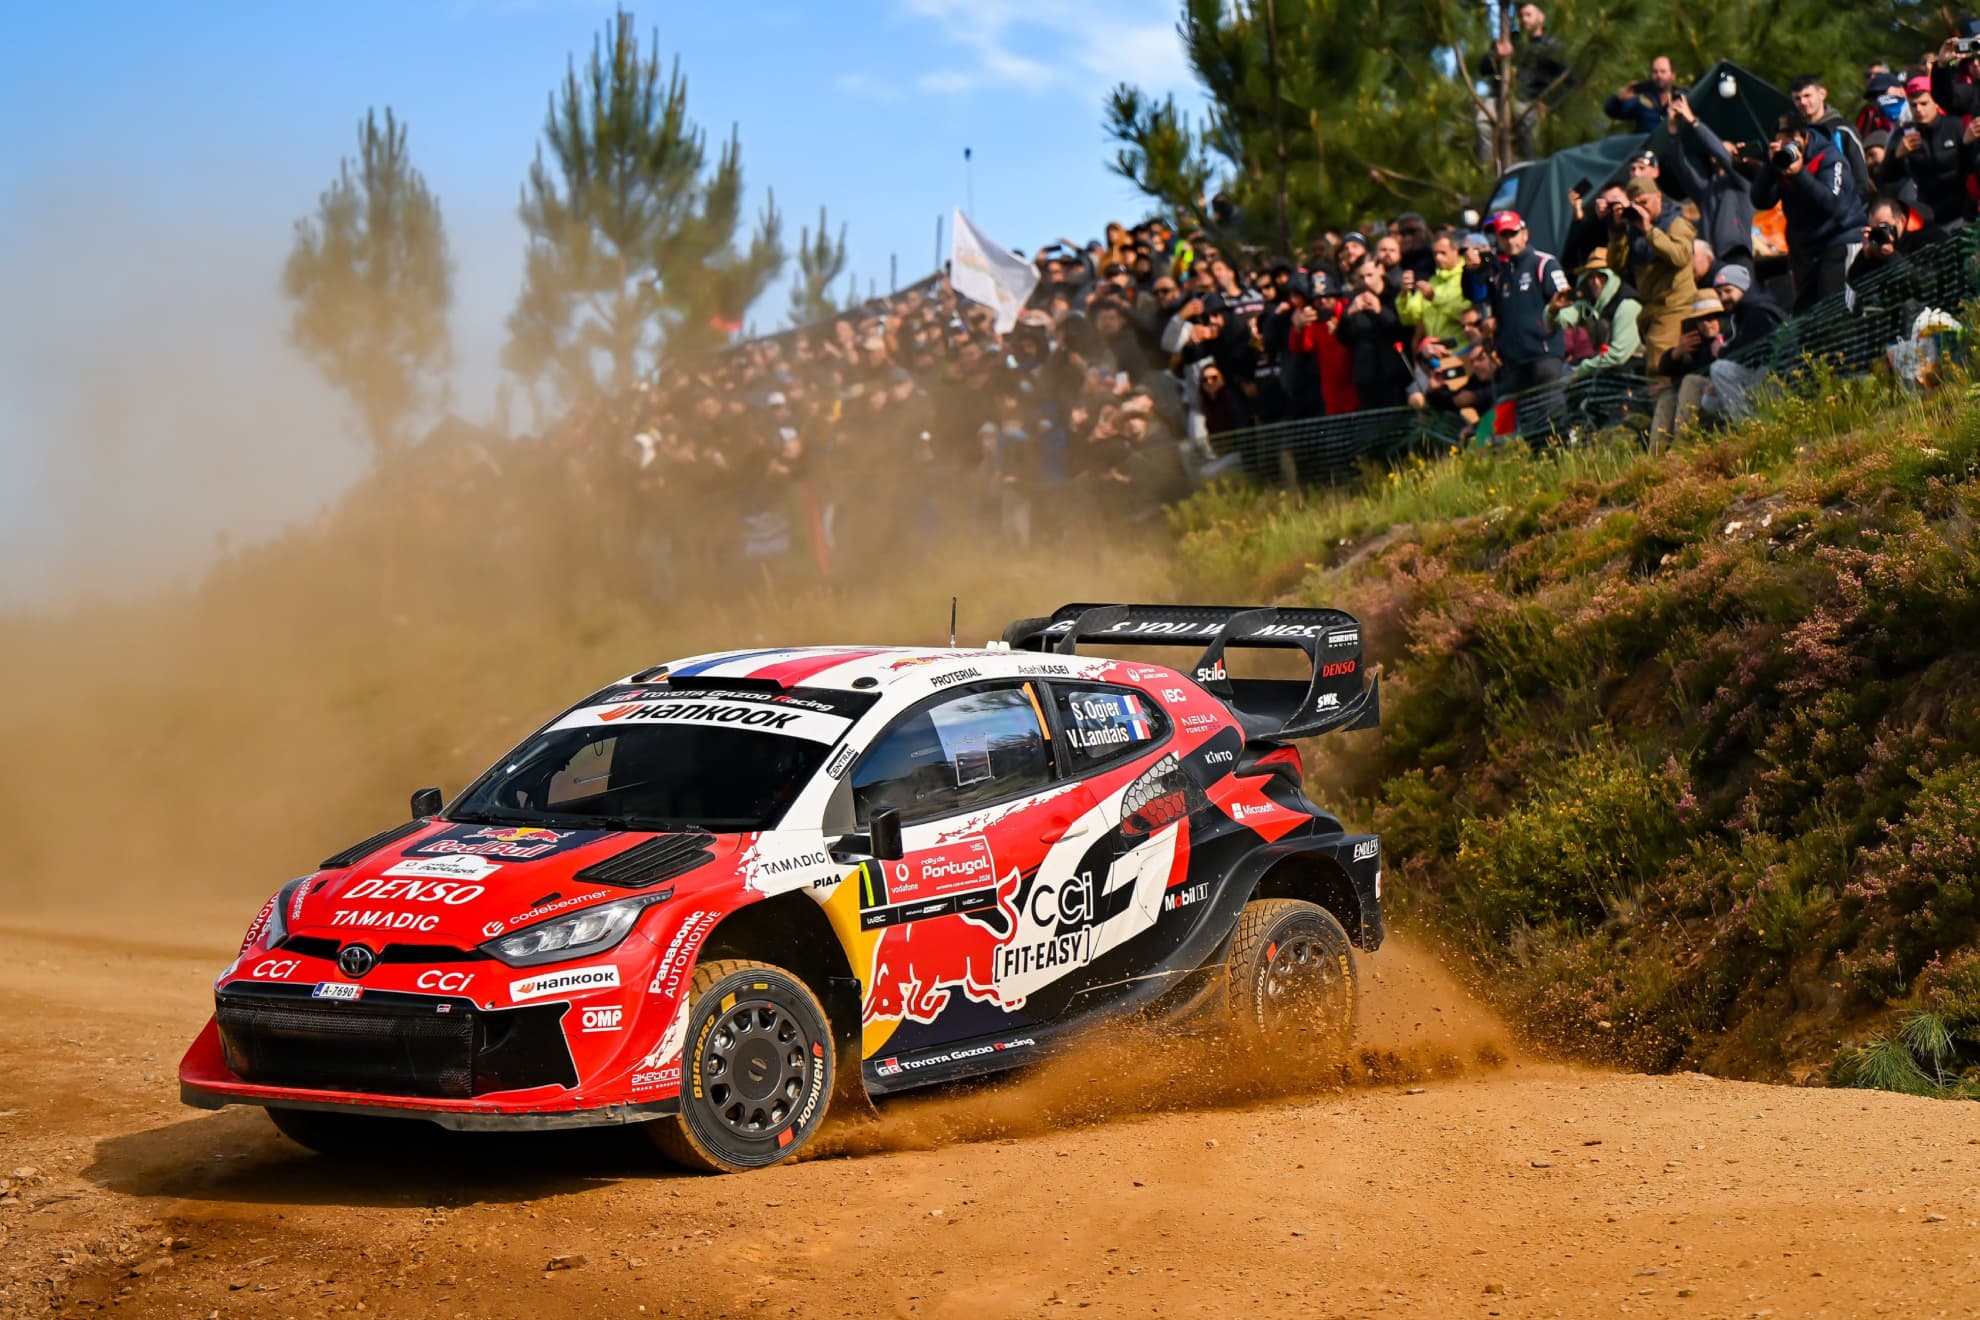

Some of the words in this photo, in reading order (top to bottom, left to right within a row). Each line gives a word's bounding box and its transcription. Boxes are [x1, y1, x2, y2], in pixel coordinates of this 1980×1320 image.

[1129, 622, 1198, 633] YOU
[930, 667, 982, 688] PROTERIAL
[1197, 660, 1226, 682] Stilo
[1322, 660, 1356, 678] DENSO
[642, 690, 706, 698] TOYOTA
[773, 695, 834, 711] Racing
[1071, 700, 1120, 722] S.Ogier
[1066, 723, 1130, 748] V.Landais
[829, 748, 855, 778] CENTRAL
[1242, 802, 1274, 815] Microsoft
[760, 852, 826, 875] TAMADIC
[922, 855, 990, 880] Portugal
[342, 879, 485, 905] DENSO
[813, 874, 842, 889] PIAA
[891, 883, 918, 894] vodafone
[509, 890, 606, 925] codebeamer
[1165, 886, 1196, 911] Mobil
[331, 911, 439, 932] TAMADIC
[648, 910, 705, 994] Panasonic
[664, 910, 722, 999] AUTOMOTIVE
[322, 985, 354, 997] A-7690
[582, 1009, 622, 1028] OMP
[901, 1055, 950, 1070] TOYOTA
[951, 1046, 994, 1060] GAZOO
[994, 1038, 1035, 1053] Racing
